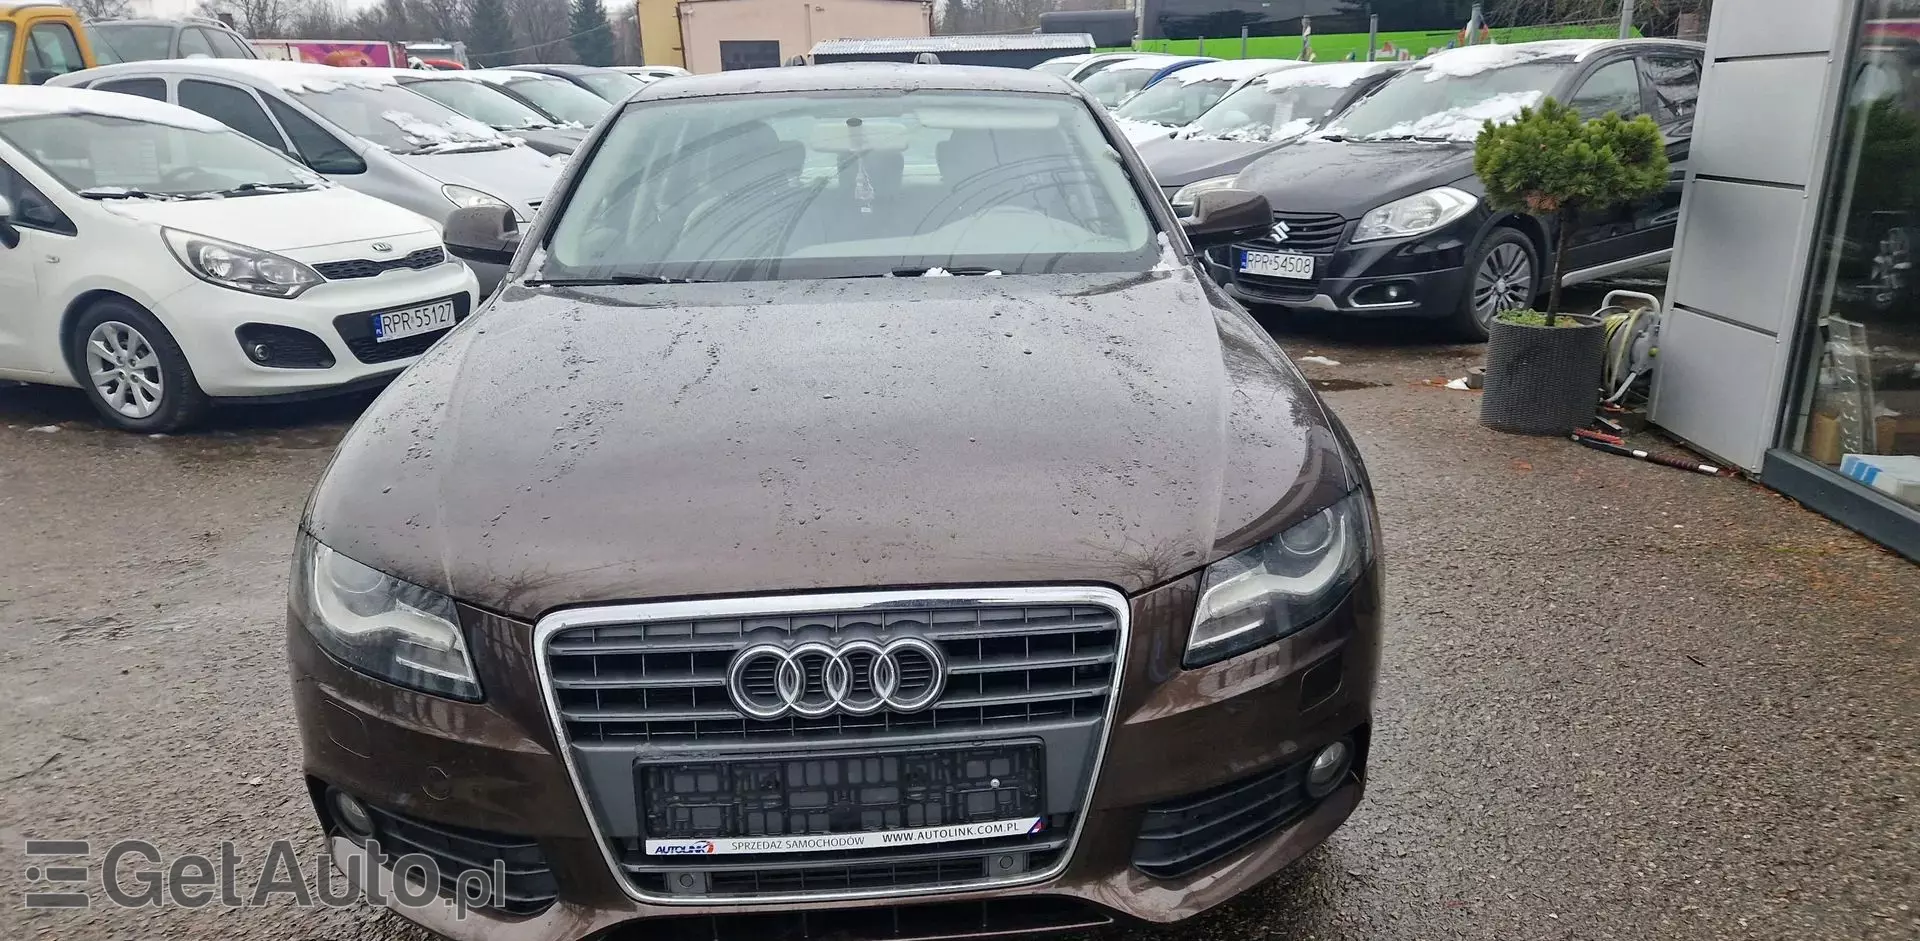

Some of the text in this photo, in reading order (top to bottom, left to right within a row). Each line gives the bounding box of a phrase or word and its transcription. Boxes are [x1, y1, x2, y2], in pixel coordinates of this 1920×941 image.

[1247, 252, 1312, 274] RPR 54508
[382, 303, 452, 335] RPR 55127
[785, 836, 865, 849] SAMOCHODÓW
[882, 822, 1020, 843] WWW.AUTOLINK.COM.PL
